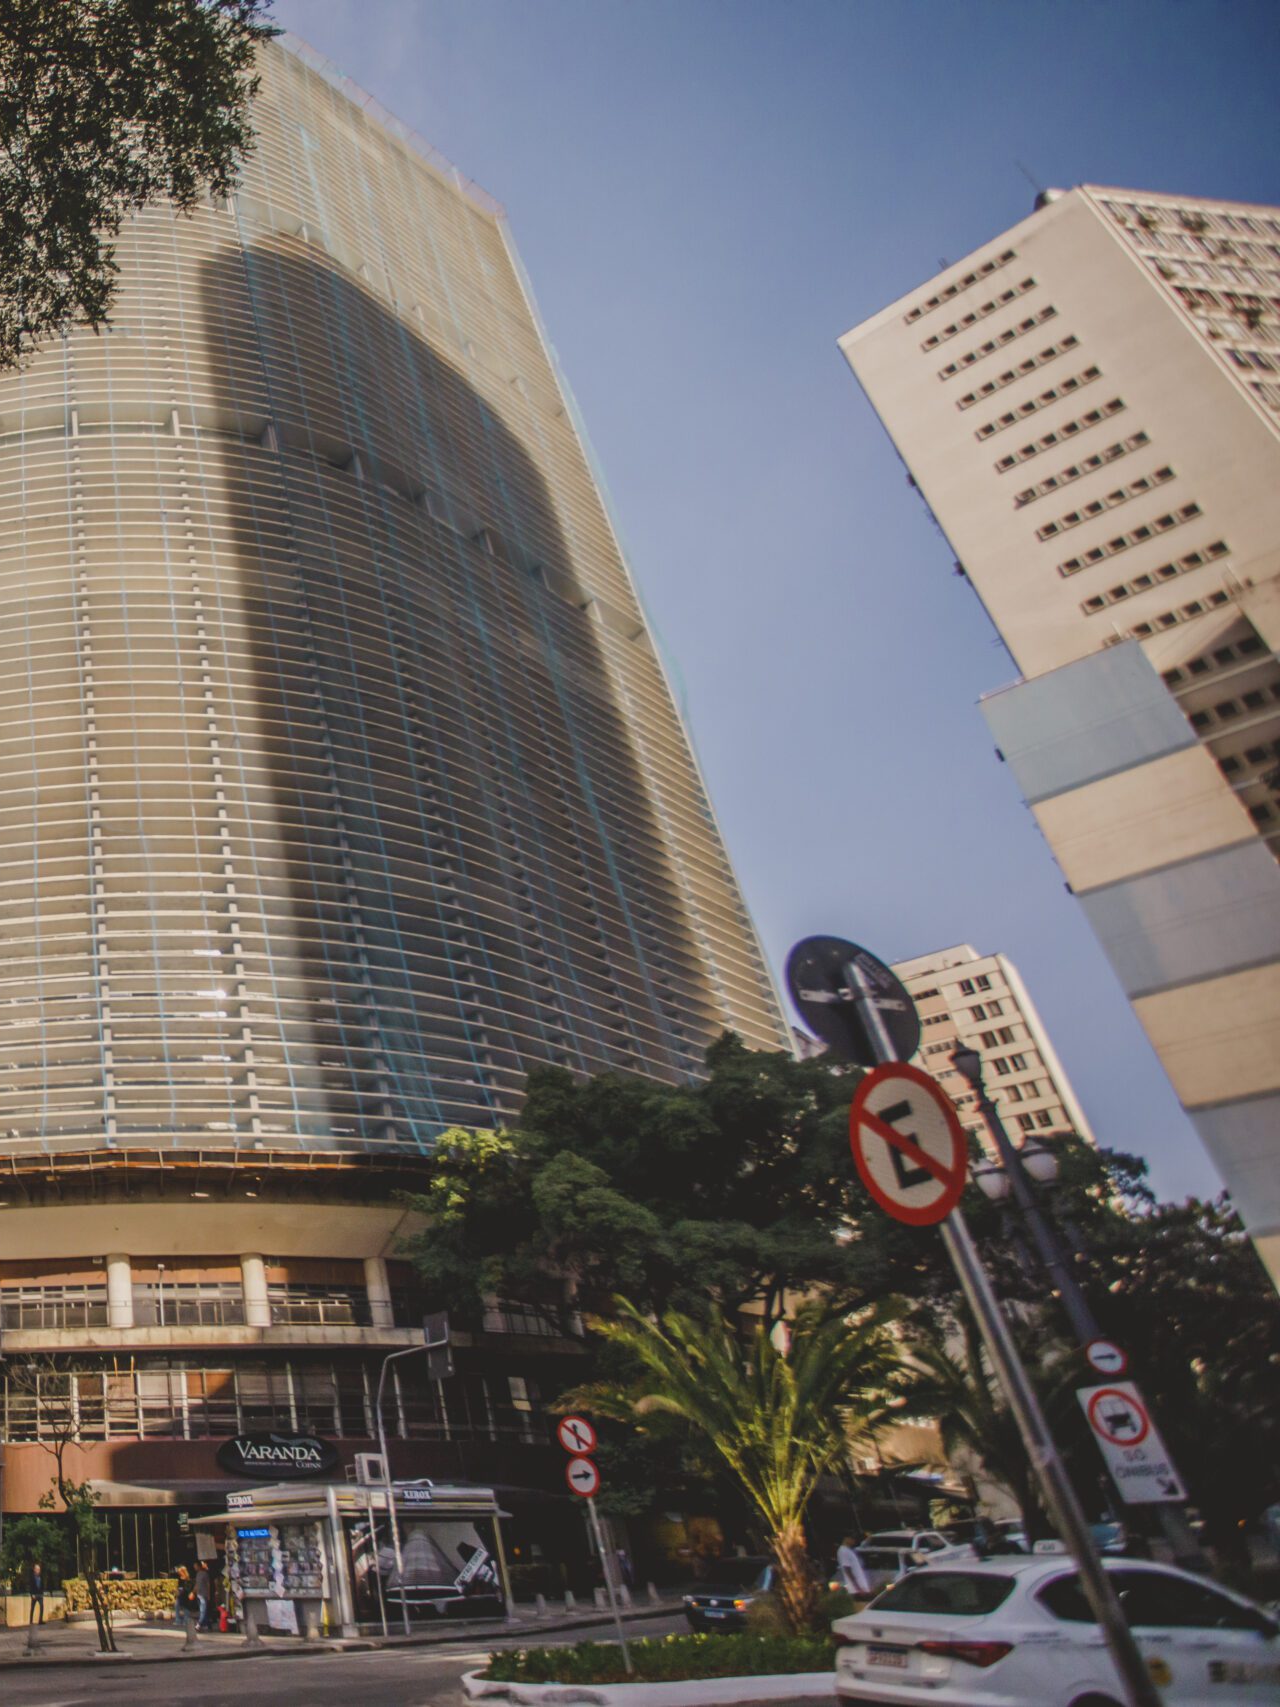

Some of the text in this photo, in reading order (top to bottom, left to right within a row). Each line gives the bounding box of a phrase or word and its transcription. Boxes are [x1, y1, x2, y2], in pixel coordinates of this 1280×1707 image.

[235, 1440, 322, 1461] VARANDA
[403, 1490, 431, 1499] XEROX
[227, 1495, 253, 1506] XEROX
